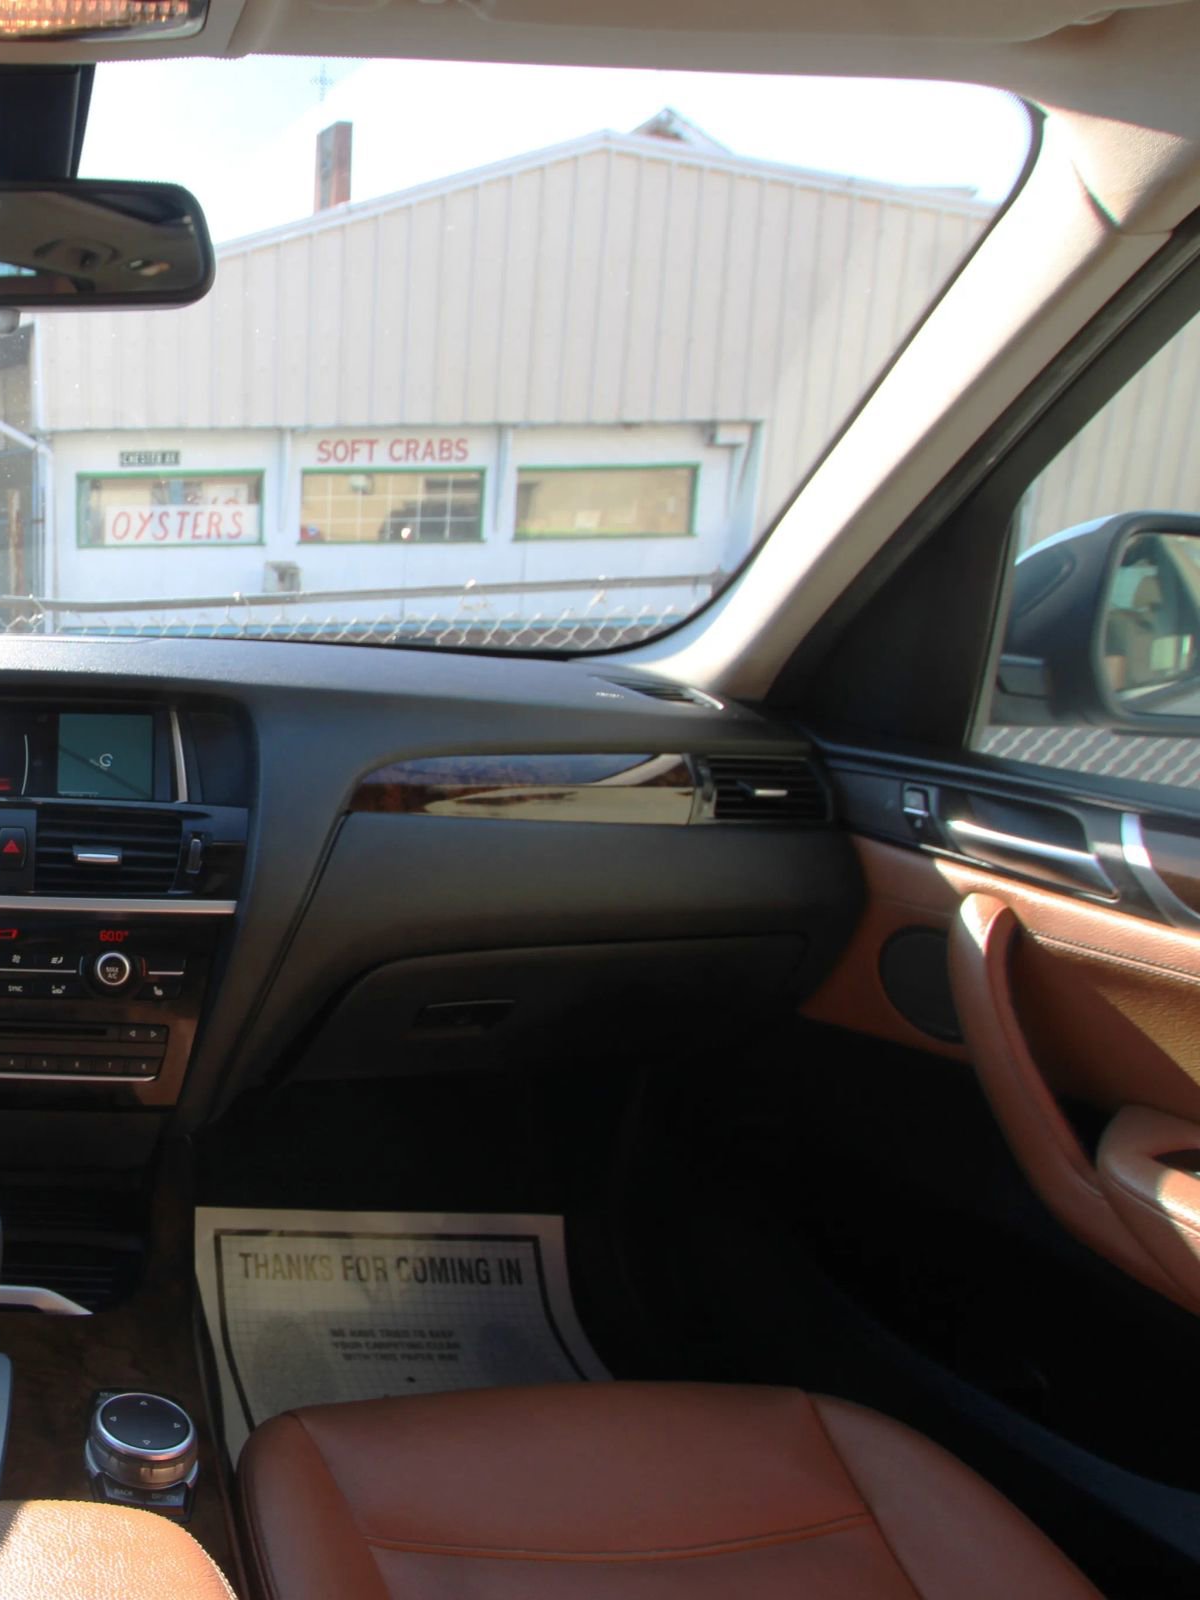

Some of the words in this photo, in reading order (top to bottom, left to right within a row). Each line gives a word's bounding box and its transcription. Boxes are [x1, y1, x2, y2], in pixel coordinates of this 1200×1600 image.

[317, 438, 379, 463] SOFT
[389, 437, 468, 462] CRABS
[112, 510, 242, 541] OYSTERS
[7, 985, 24, 993] SYNC
[238, 1252, 335, 1281] THANKS
[342, 1254, 389, 1283] FOR
[396, 1256, 490, 1285] COMING
[498, 1257, 523, 1286] IN
